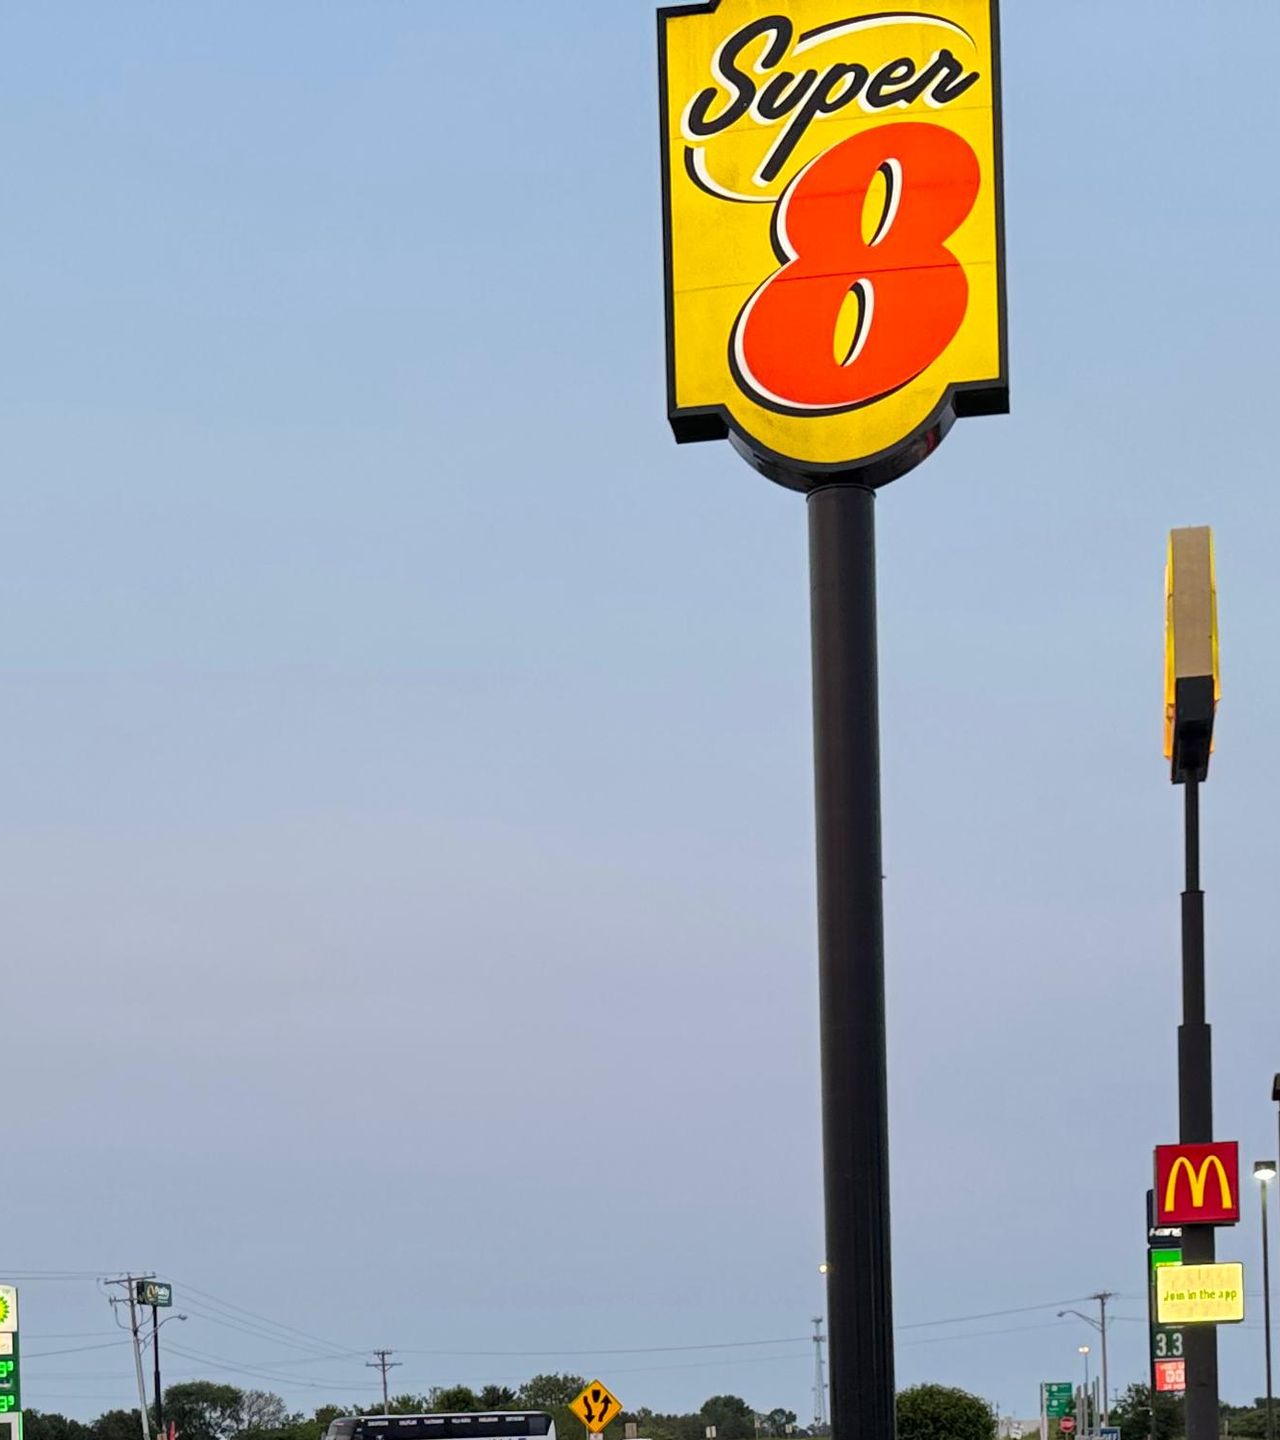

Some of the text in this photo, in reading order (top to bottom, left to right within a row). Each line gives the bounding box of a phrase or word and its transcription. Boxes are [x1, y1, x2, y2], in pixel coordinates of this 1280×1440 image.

[686, 15, 980, 185] Super
[728, 122, 981, 417] 8
[1199, 1289, 1216, 1299] the
[1218, 1290, 1237, 1301] app
